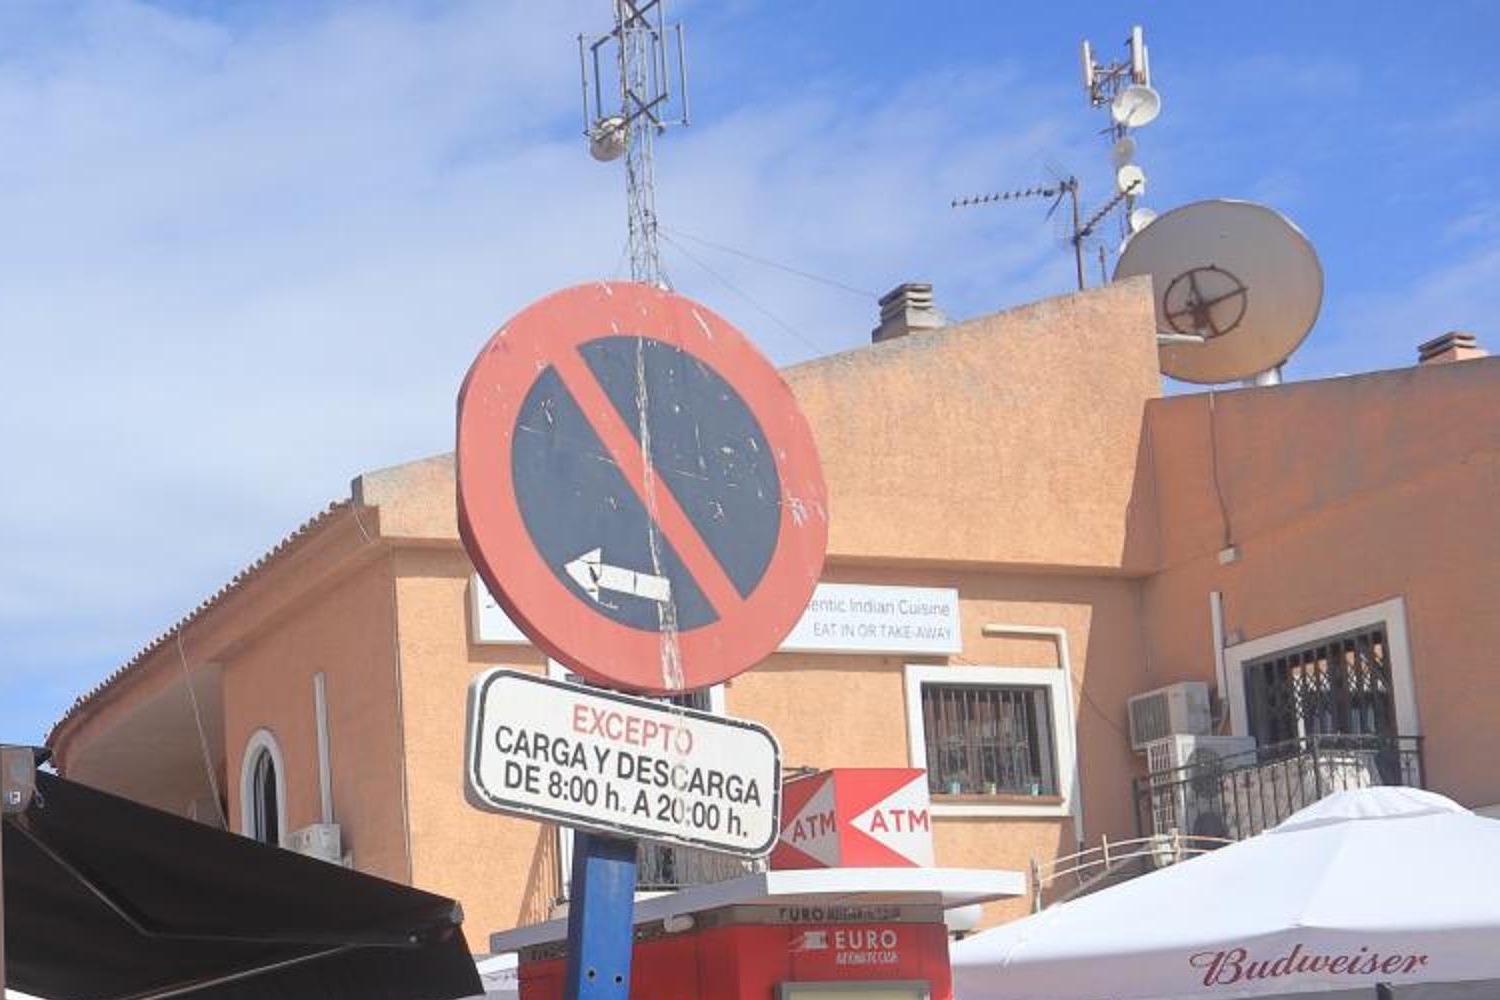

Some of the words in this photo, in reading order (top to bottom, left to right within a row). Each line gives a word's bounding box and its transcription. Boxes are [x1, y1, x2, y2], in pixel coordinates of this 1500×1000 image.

[850, 599, 894, 615] Indian
[899, 600, 950, 616] Cuisine
[813, 622, 836, 637] EAT
[841, 623, 855, 637] IN
[857, 623, 877, 638] OR
[573, 704, 693, 755] EXCEPTO
[495, 725, 588, 770] CARGA
[594, 748, 610, 774] Y
[617, 751, 761, 807] DESCARGA
[505, 760, 540, 794] DE
[548, 771, 598, 807] 8:00
[605, 782, 627, 812] h.
[633, 790, 650, 817] A
[657, 793, 719, 830] 20:00
[727, 807, 748, 838] h.
[792, 810, 836, 843] ATM
[870, 809, 929, 833] ATM
[835, 930, 897, 949] EURO
[1189, 944, 1428, 987] Budweiser
